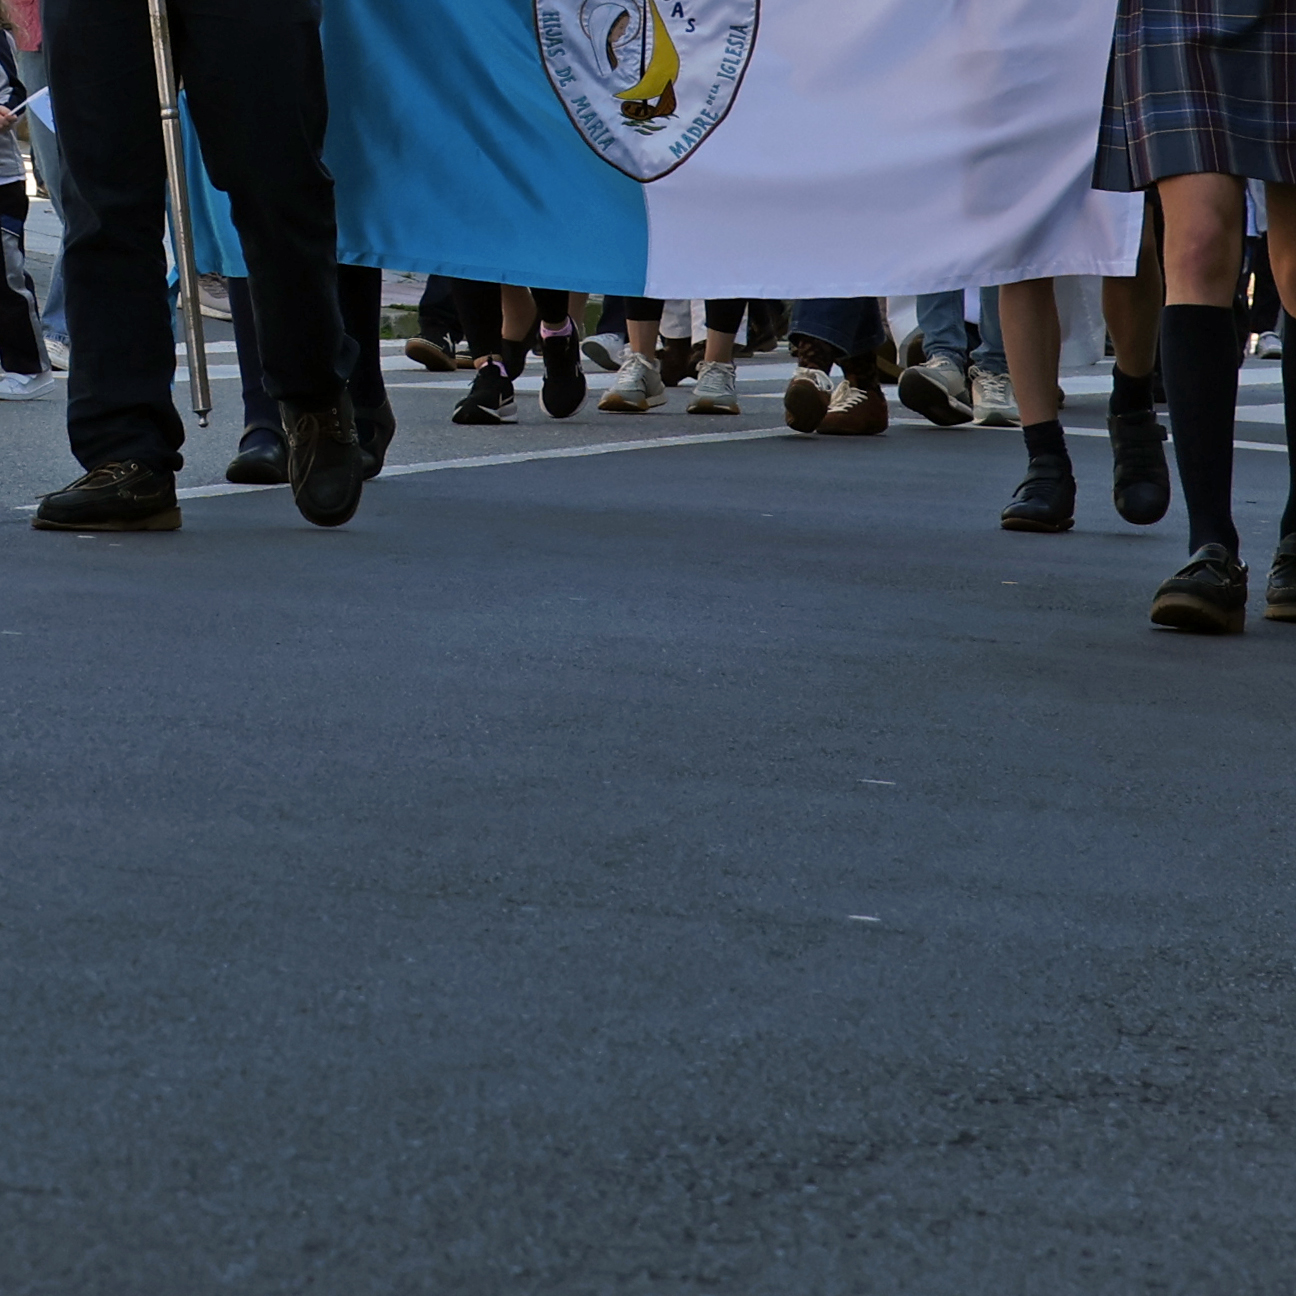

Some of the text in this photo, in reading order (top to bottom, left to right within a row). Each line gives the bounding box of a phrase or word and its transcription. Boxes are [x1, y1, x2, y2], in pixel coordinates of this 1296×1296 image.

[542, 10, 616, 152] HIJAS DE MARIA
[668, 108, 719, 159] MADRE
[716, 24, 749, 82] IGLESIA
